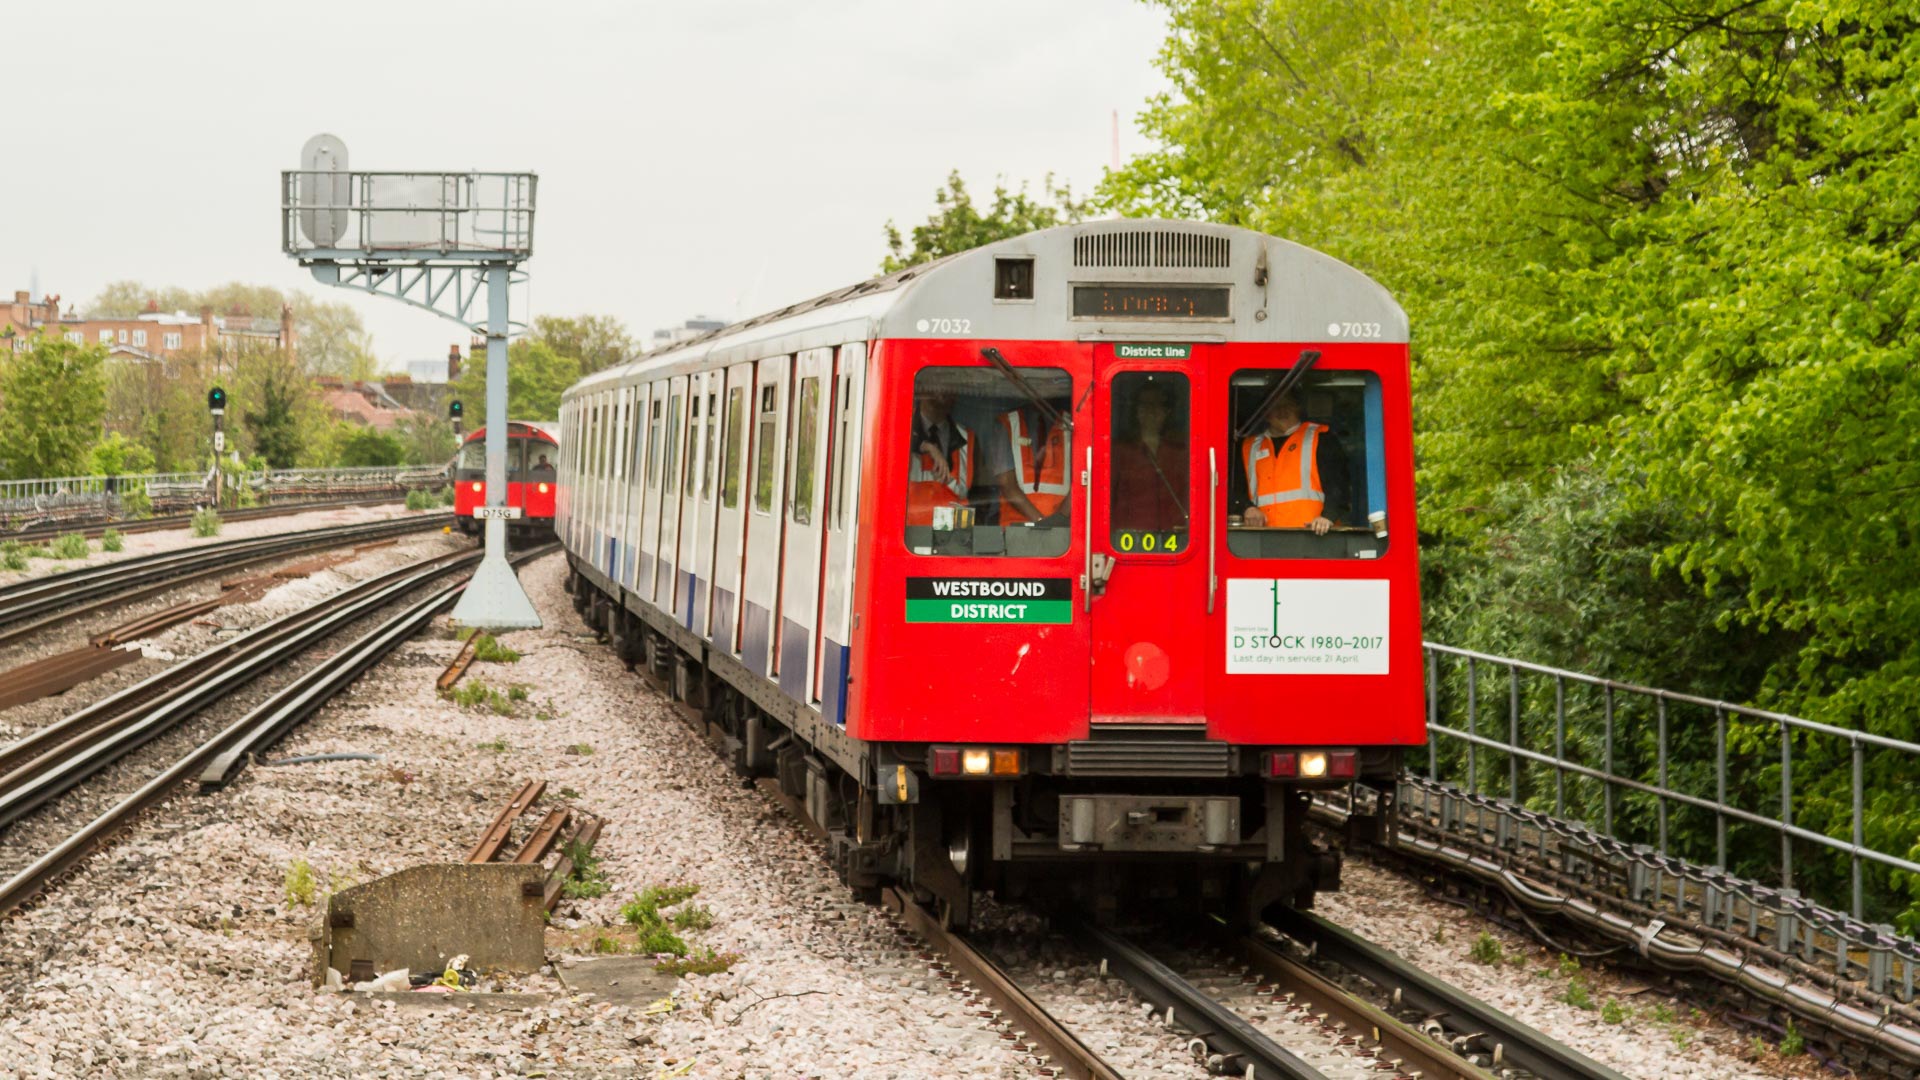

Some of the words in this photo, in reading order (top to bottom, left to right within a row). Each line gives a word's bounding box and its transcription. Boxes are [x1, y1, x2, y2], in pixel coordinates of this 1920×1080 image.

[931, 318, 971, 334] 7032
[1342, 322, 1381, 338] 7032
[1121, 345, 1162, 357] District
[1165, 346, 1186, 357] line
[1120, 533, 1178, 551] 004
[932, 581, 1046, 597] WESTBOUND
[950, 604, 1028, 619] DISTRICT
[1233, 635, 1245, 649] D
[1251, 635, 1305, 649] STOCK
[1233, 655, 1253, 663] Last
[1256, 654, 1273, 664] day
[1276, 654, 1285, 663] in
[1287, 654, 1322, 663] service
[1324, 654, 1333, 663] 21
[1335, 654, 1359, 665] April
